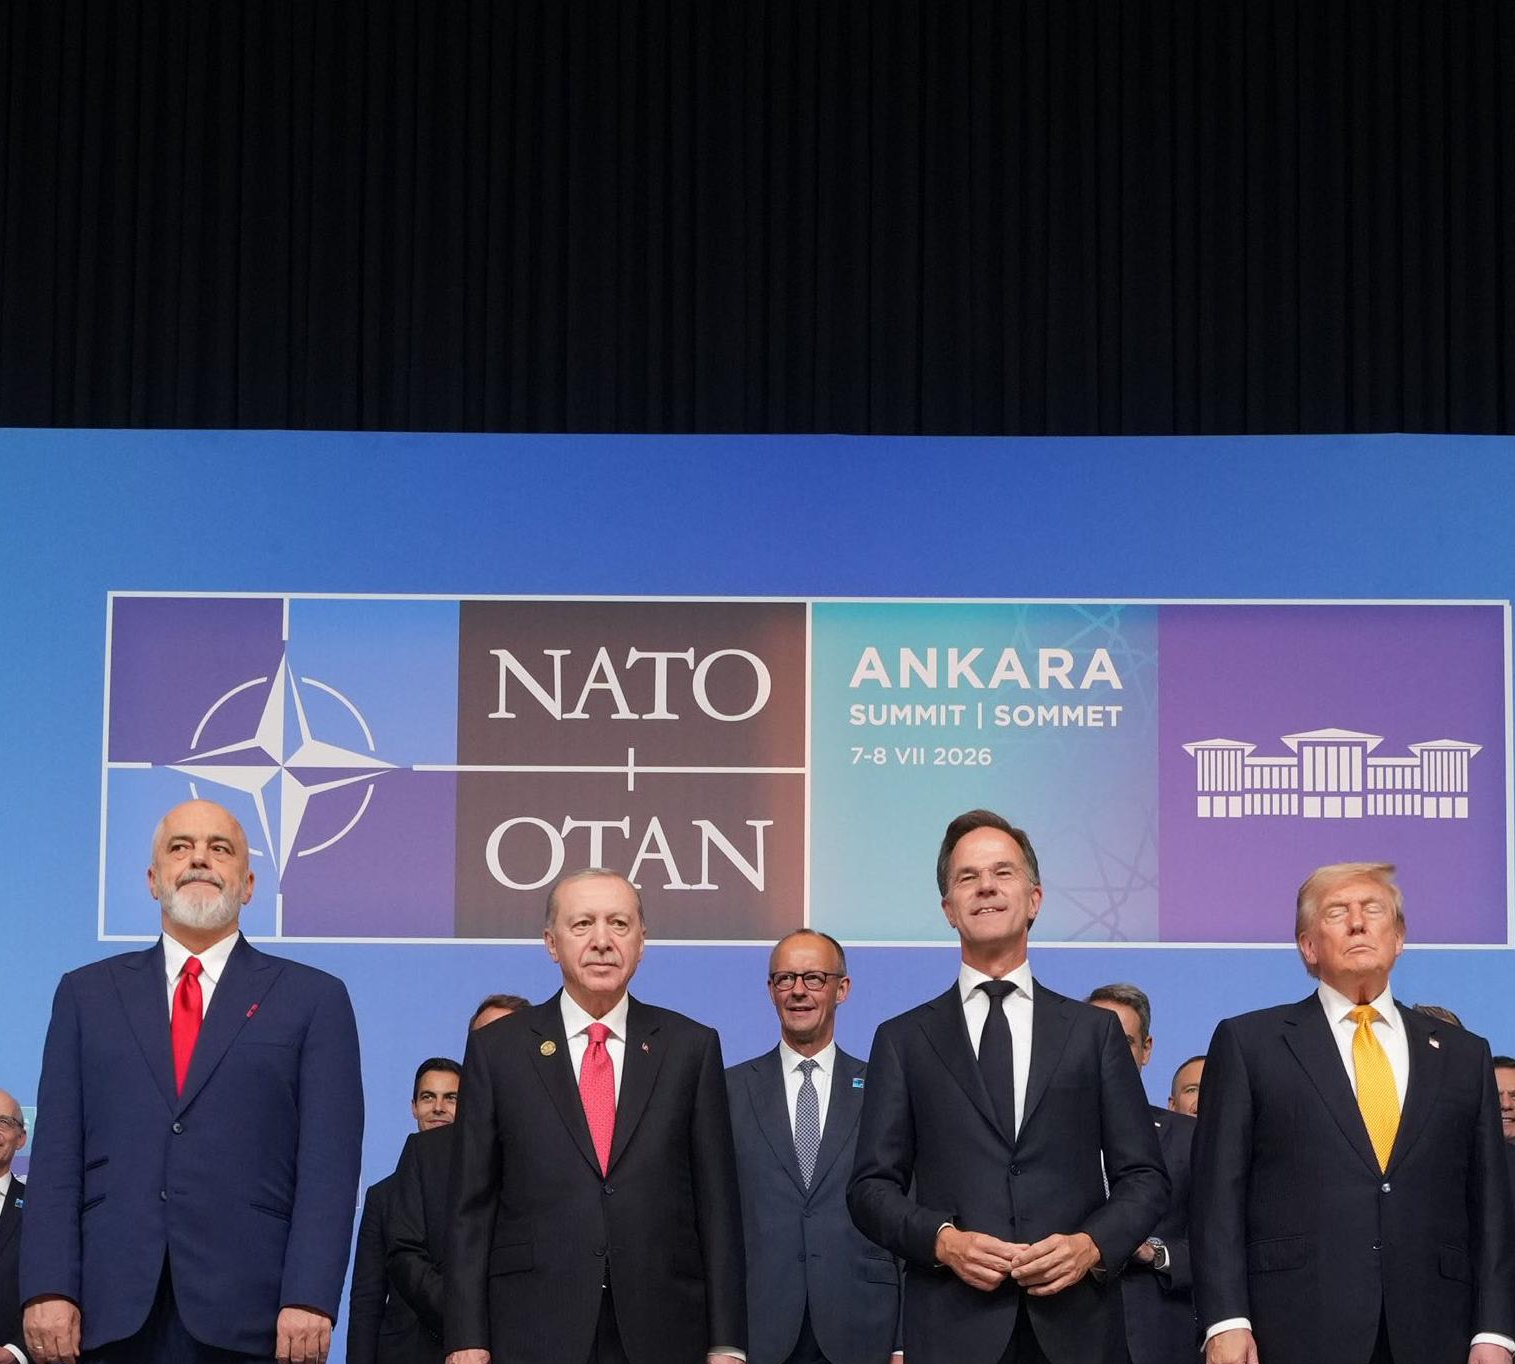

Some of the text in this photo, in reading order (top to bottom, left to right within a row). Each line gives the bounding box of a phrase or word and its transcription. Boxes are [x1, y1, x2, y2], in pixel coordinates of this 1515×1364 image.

[488, 646, 772, 722] NATO
[848, 647, 1124, 690] ANKARA
[849, 704, 966, 726] SUMMIT
[994, 705, 1123, 727] SOMMET
[851, 747, 992, 766] 7-8 VII 2026
[485, 815, 774, 892] OTAN
